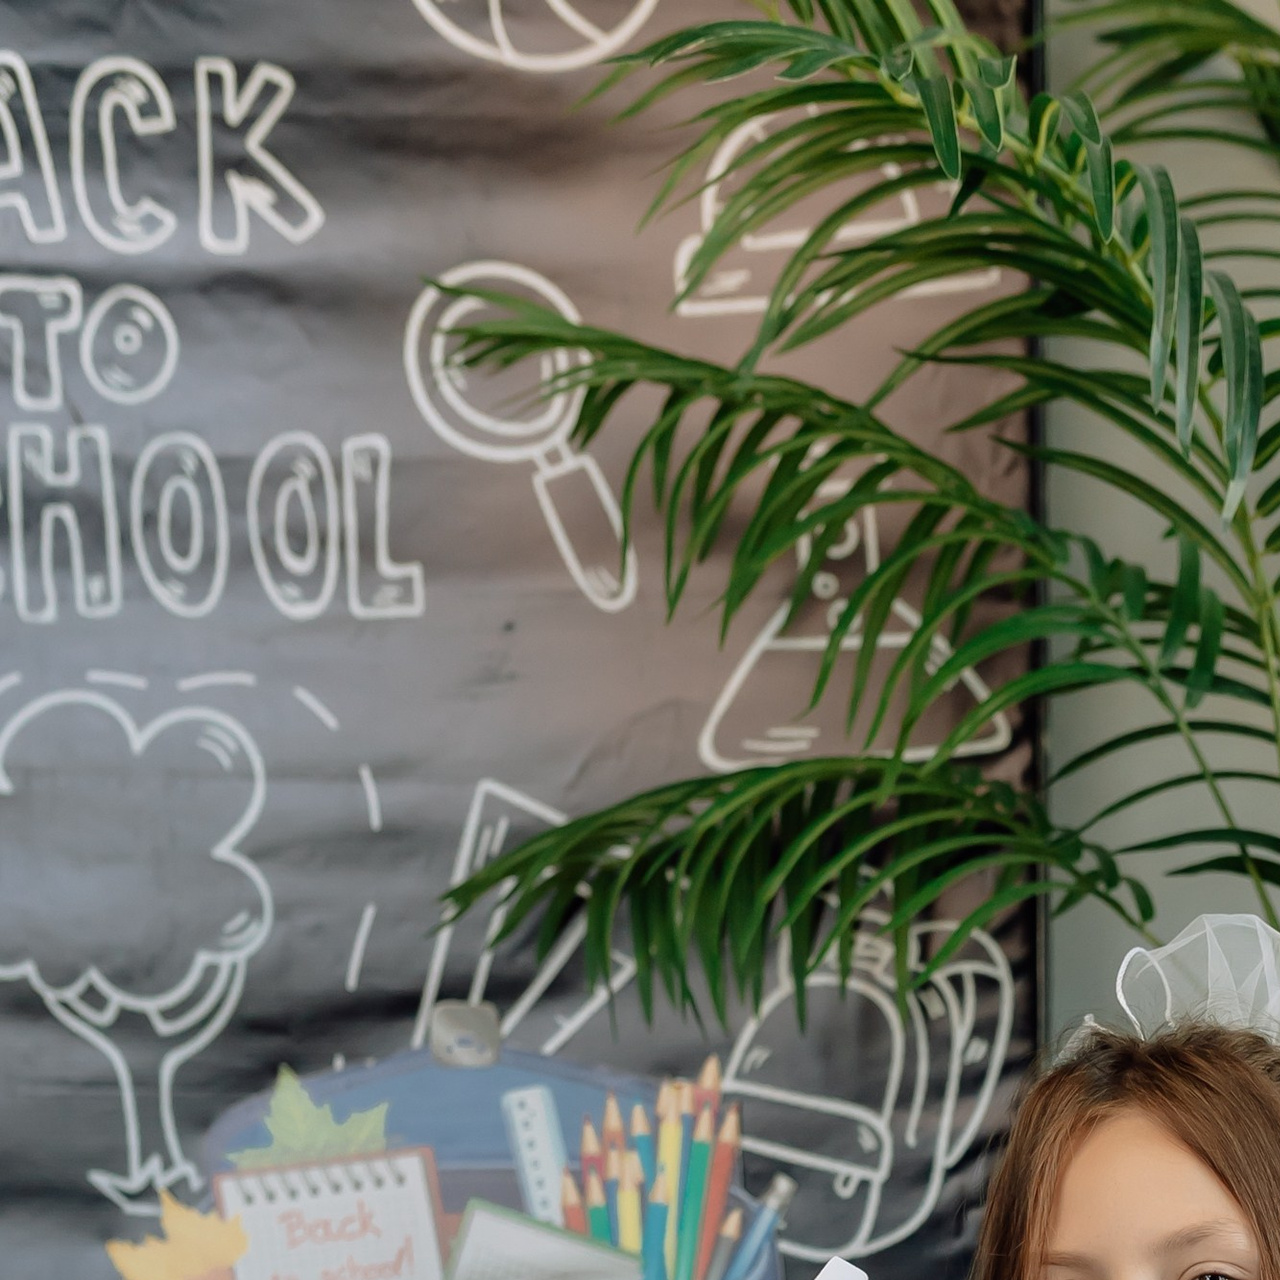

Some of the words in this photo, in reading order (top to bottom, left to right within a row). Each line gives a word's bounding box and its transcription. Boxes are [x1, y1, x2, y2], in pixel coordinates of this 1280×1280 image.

[0, 275, 179, 406] TO
[0, 423, 424, 623] HOOL
[276, 1198, 383, 1250] Back
